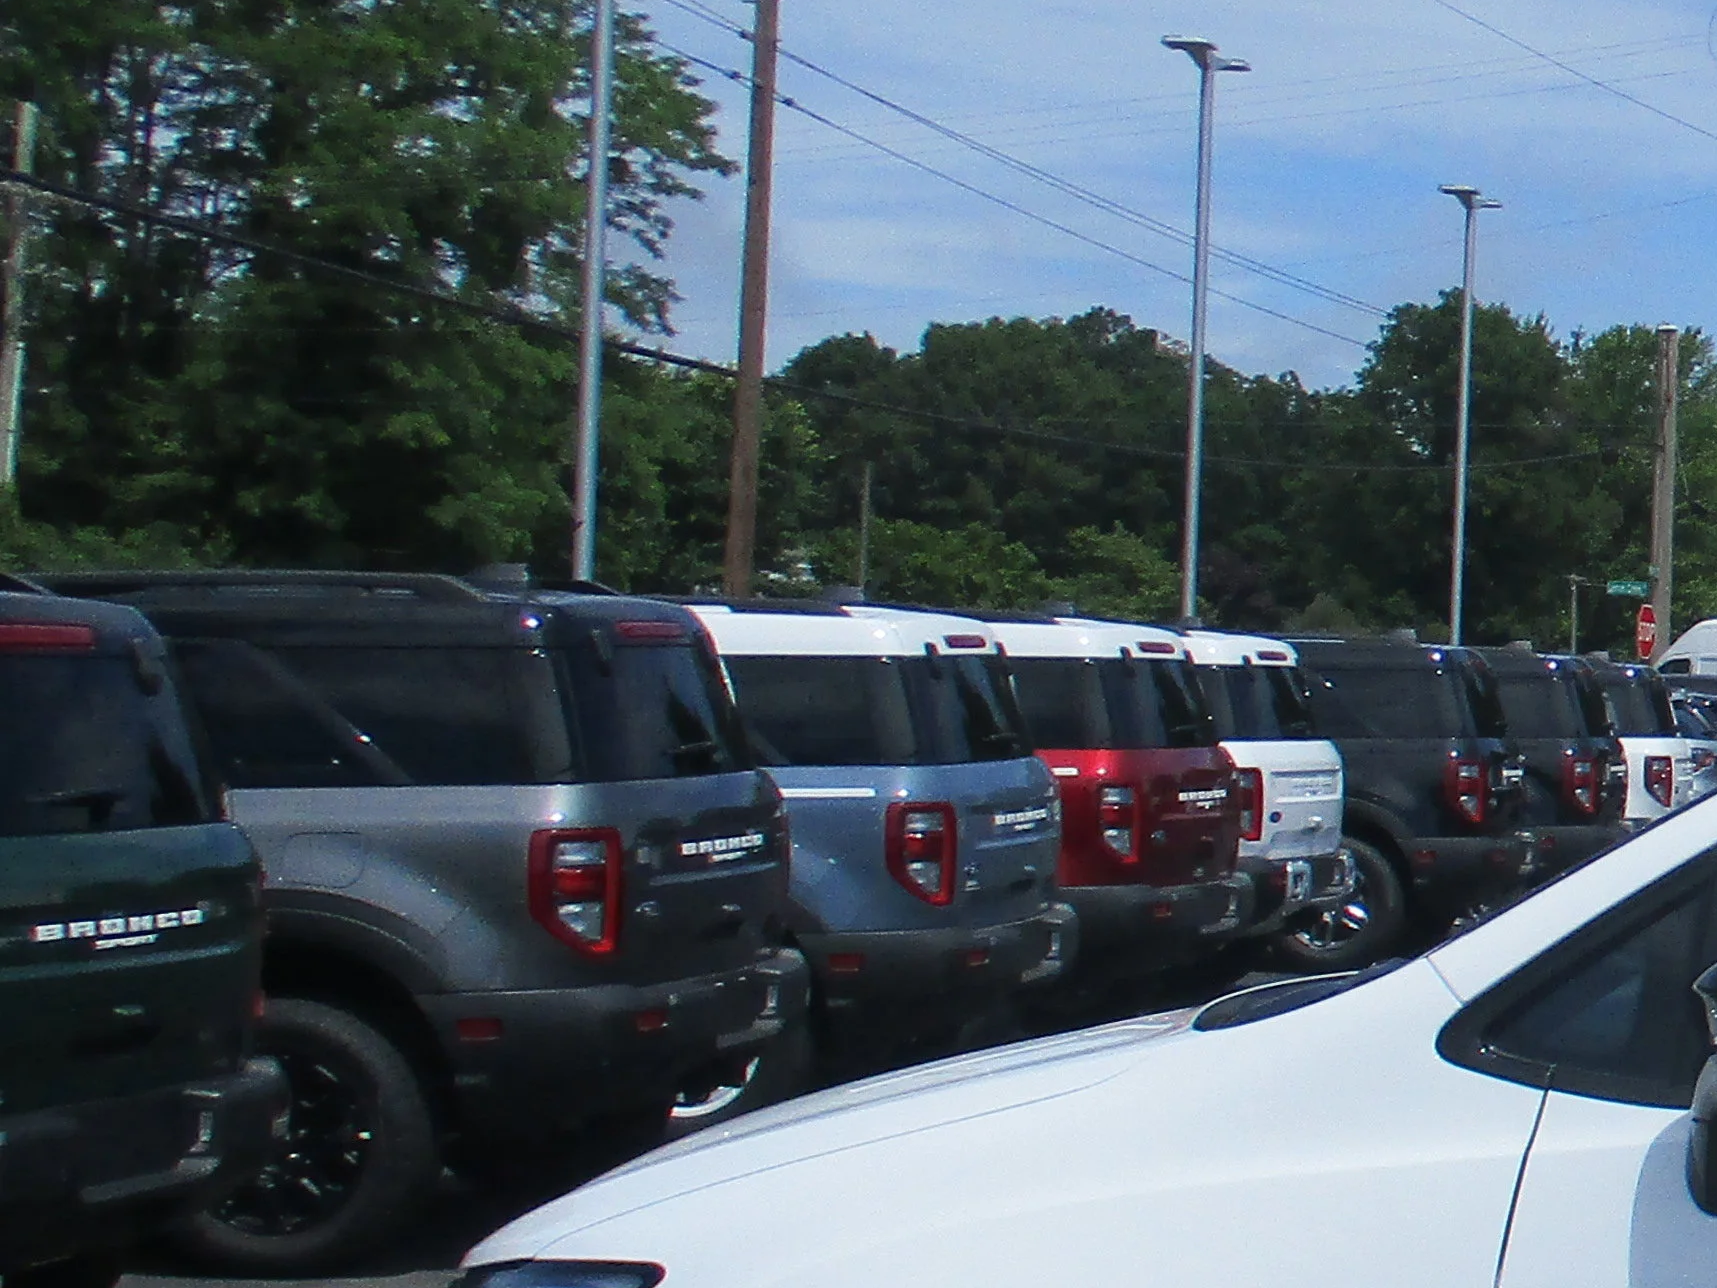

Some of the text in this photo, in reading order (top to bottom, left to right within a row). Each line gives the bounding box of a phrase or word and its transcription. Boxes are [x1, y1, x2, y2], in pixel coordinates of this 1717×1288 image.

[1638, 622, 1655, 641] STOP
[678, 833, 764, 855] BRONCO
[29, 909, 203, 942] BRONCO
[93, 933, 158, 950] SPORT
